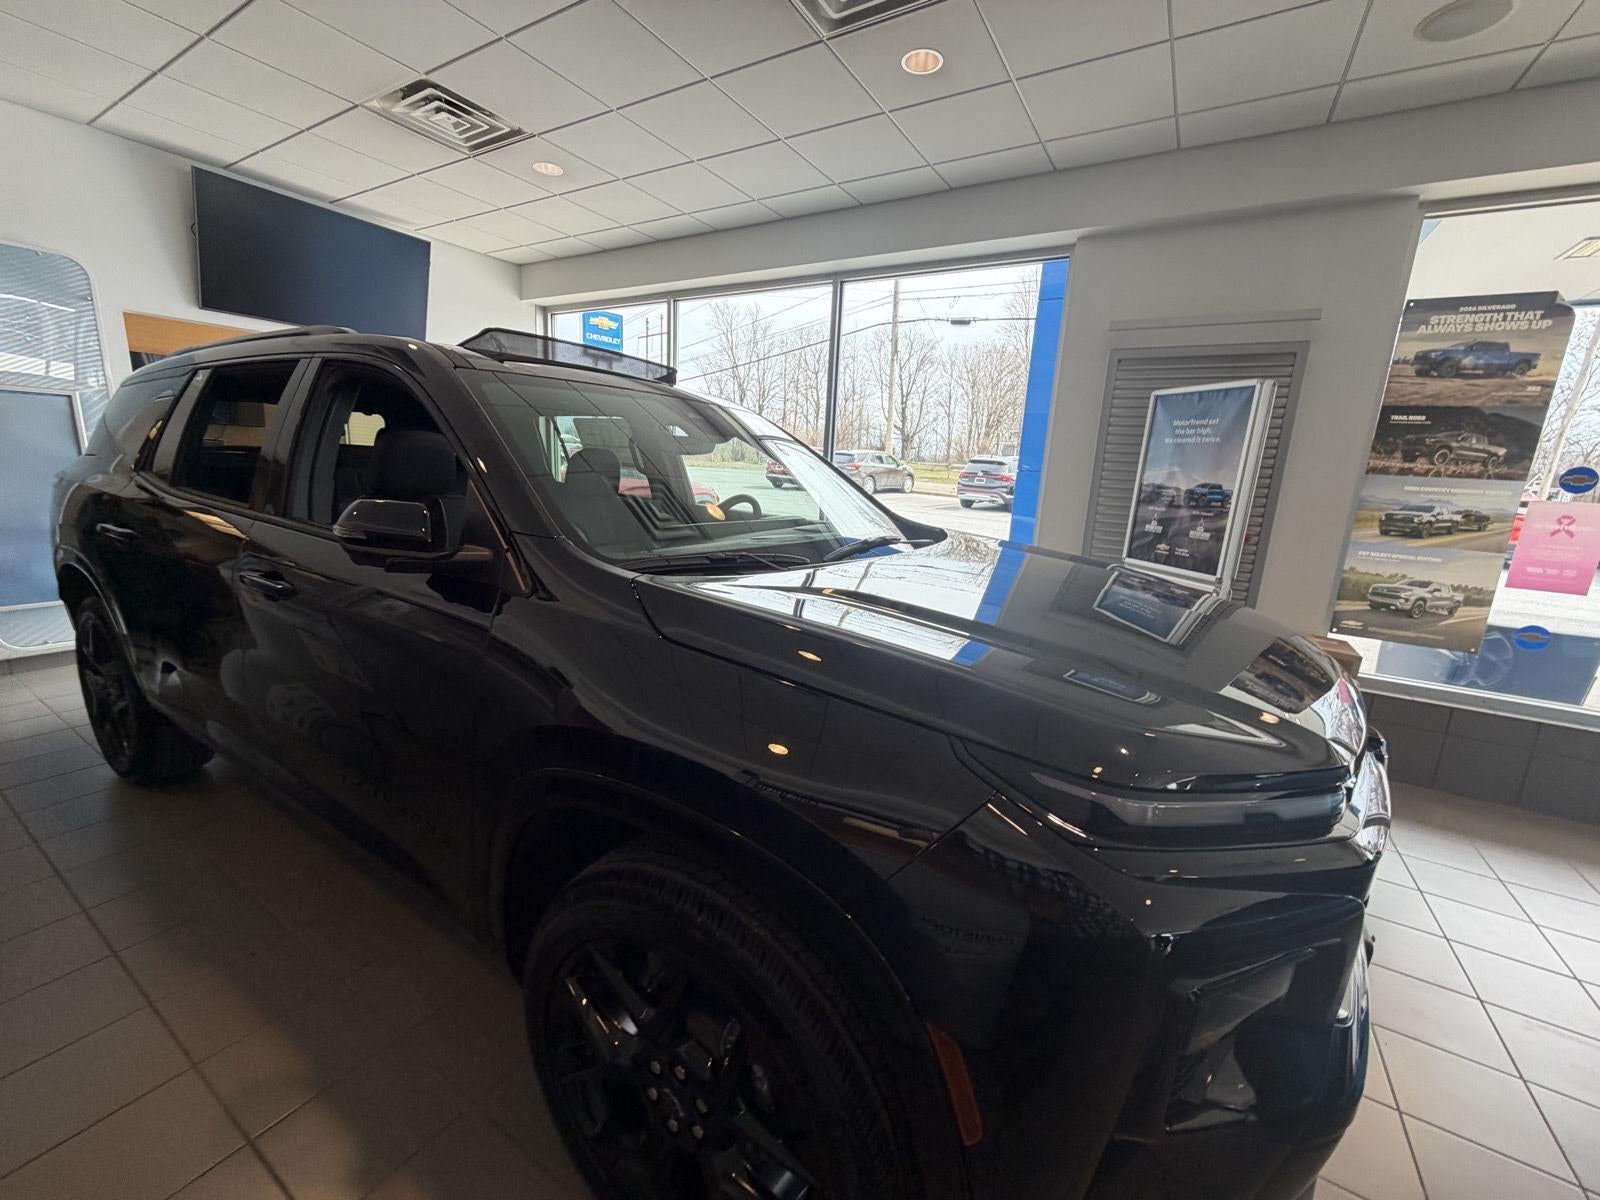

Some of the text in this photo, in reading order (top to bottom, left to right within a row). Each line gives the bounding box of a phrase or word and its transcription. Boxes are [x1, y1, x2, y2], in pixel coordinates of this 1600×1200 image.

[1429, 310, 1544, 325] STRENGTH THAT
[1416, 319, 1553, 335] ALWAYS SHOWS UP
[586, 332, 621, 345] CHEVROLET
